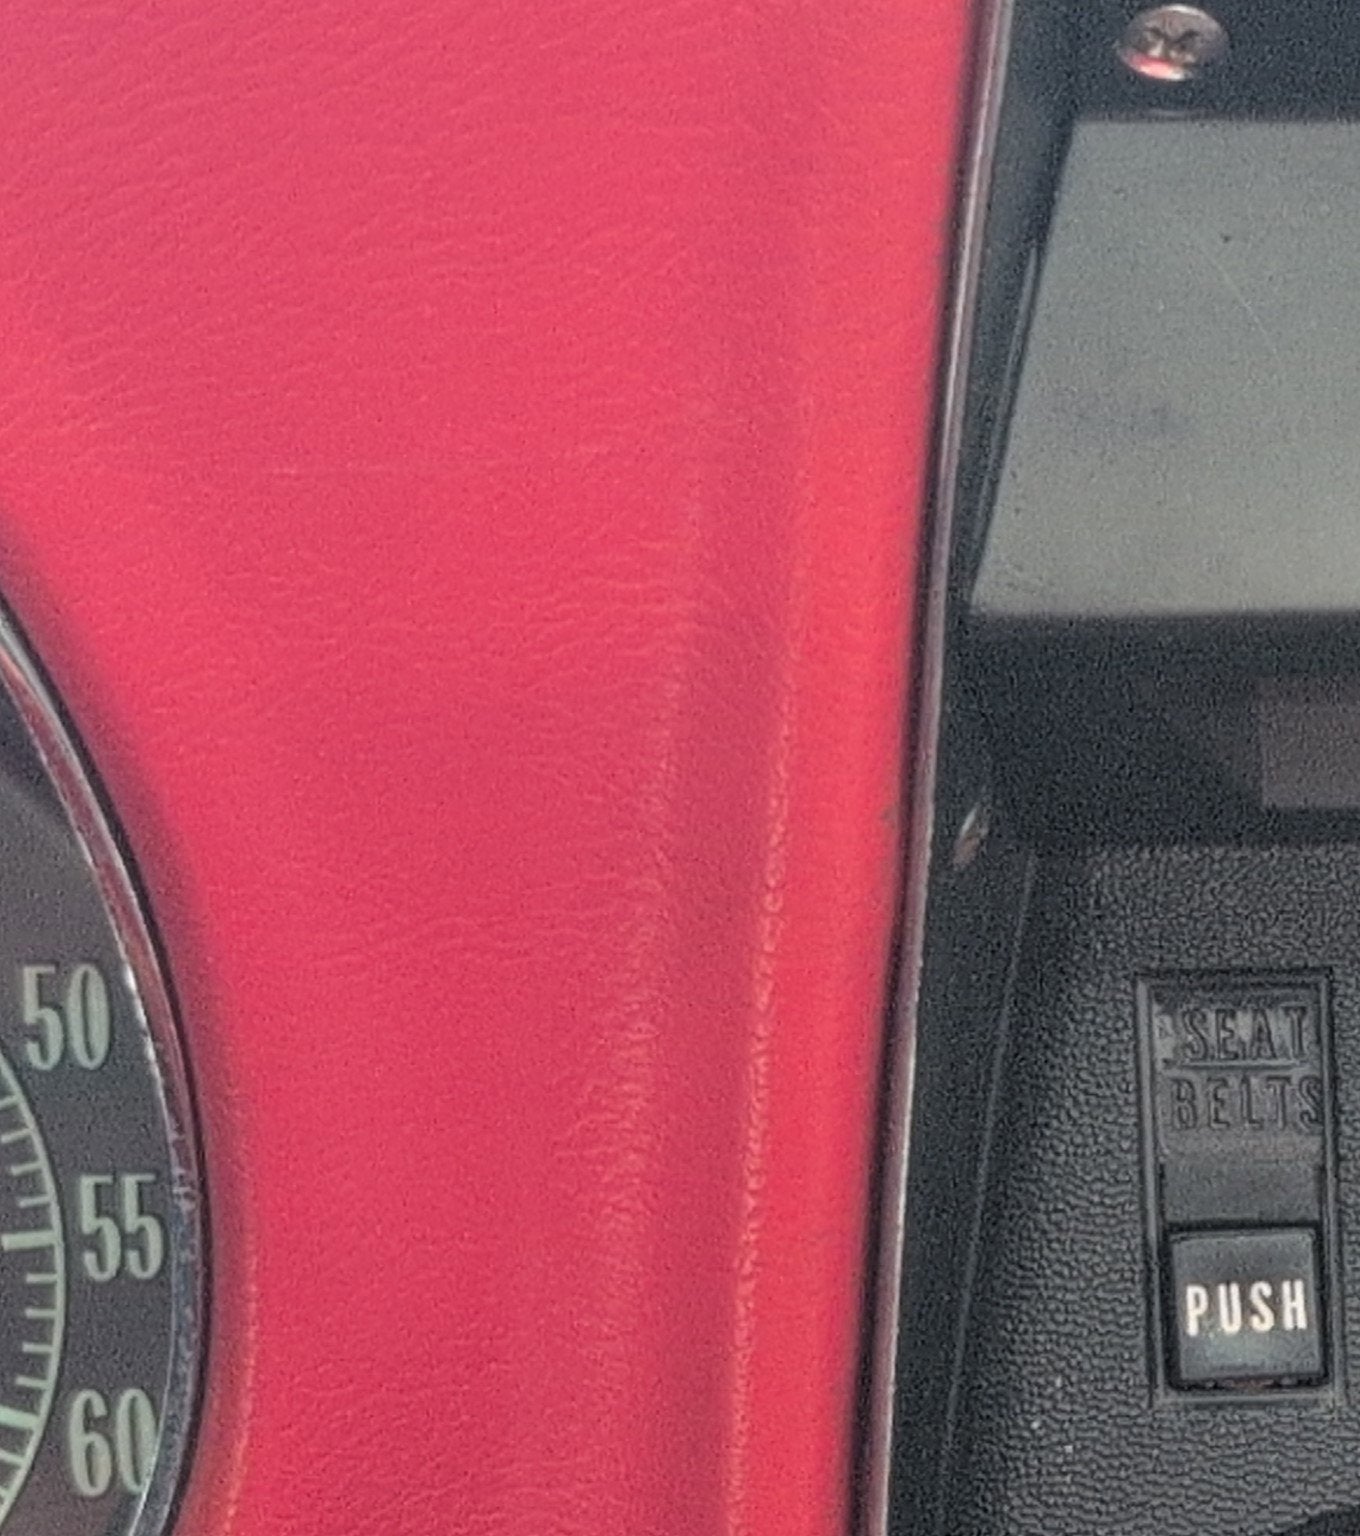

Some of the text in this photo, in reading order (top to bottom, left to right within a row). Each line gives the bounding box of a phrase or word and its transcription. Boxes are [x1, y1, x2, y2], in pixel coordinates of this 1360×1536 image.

[20, 964, 110, 1071] 50
[1182, 1006, 1308, 1061] SEAT
[1170, 1075, 1324, 1131] BELTS
[79, 1173, 165, 1281] 55
[1185, 1278, 1308, 1337] PUSH
[68, 1389, 159, 1497] 60
